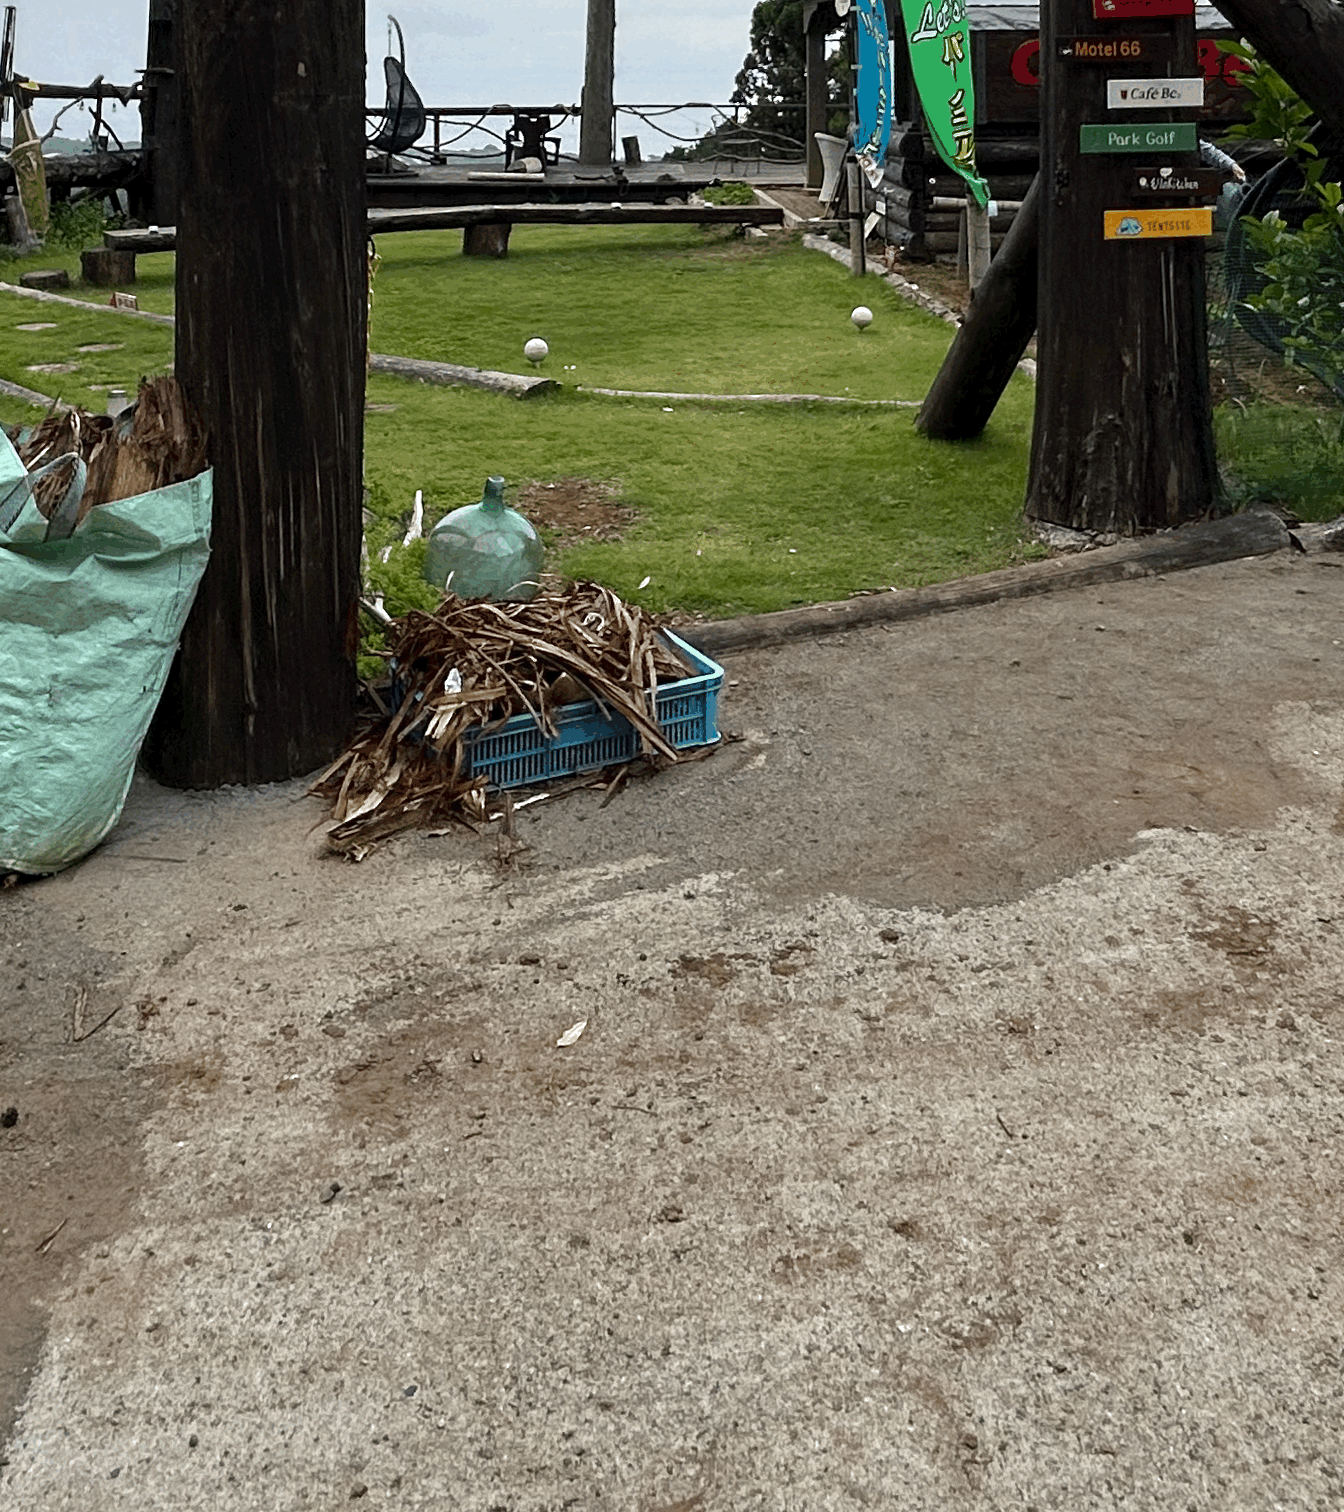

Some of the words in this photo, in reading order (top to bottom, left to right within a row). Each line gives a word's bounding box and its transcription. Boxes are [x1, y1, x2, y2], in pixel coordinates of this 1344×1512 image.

[1074, 41, 1117, 57] Motel
[1120, 40, 1141, 56] 66
[1130, 87, 1159, 101] Café
[1108, 131, 1140, 146] Park
[1145, 130, 1175, 145] Golf
